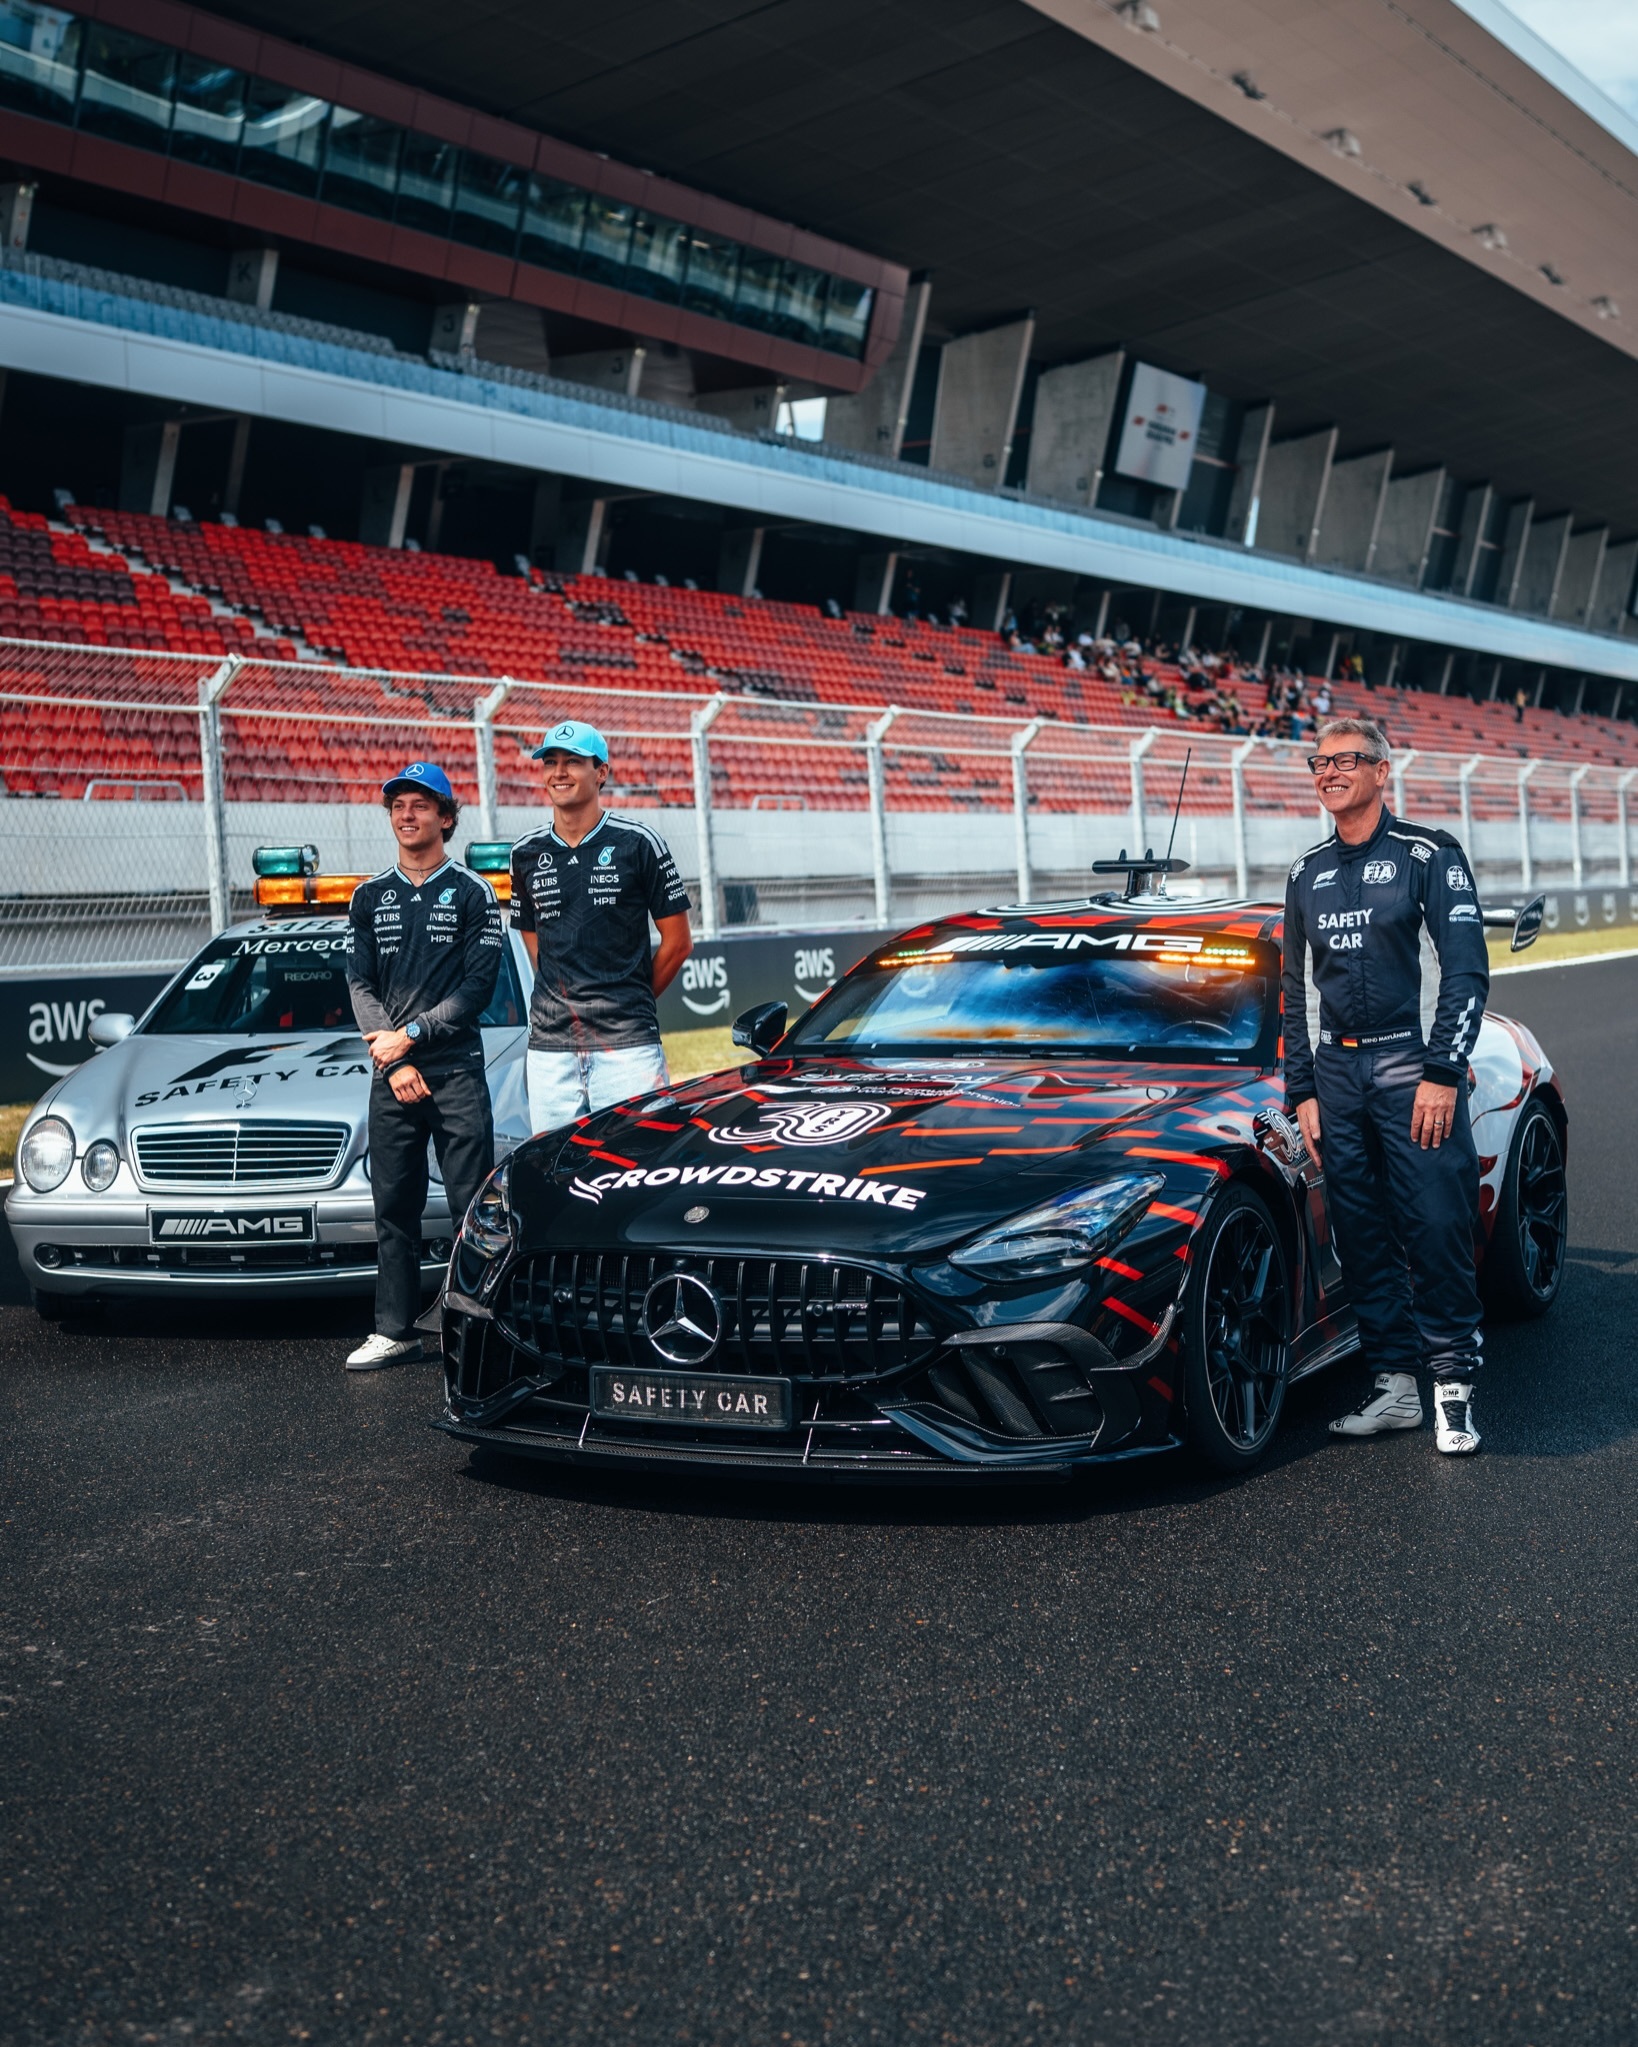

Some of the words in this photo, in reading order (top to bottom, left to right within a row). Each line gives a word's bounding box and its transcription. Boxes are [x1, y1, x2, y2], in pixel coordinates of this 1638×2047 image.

[237, 262, 252, 282] K
[1411, 846, 1431, 860] OMP
[541, 877, 558, 887] UBS
[590, 874, 620, 884] INEOS
[593, 896, 617, 906] HPE
[668, 891, 687, 902] BONV
[383, 912, 400, 922] UBS
[429, 912, 458, 923] INEOS
[1317, 908, 1374, 930] SAFETY
[248, 919, 348, 934] SAFE
[232, 936, 347, 957] Merced
[430, 935, 454, 943] HPE
[1329, 932, 1364, 950] CAR
[795, 947, 836, 981] aws
[284, 971, 333, 982] RECARO
[682, 956, 728, 991] aws
[28, 998, 106, 1045] aws
[1361, 1037, 1379, 1045] BERND
[1378, 1030, 1412, 1042] MAYLÄNDER
[134, 1068, 300, 1108] SAFETY
[315, 1065, 369, 1078] CA
[589, 1165, 927, 1211] CROWDSTRIKE
[202, 1216, 304, 1235] AMG
[612, 1381, 706, 1410] SAFETY
[717, 1389, 769, 1415] CAR
[1442, 1388, 1460, 1396] OMP
